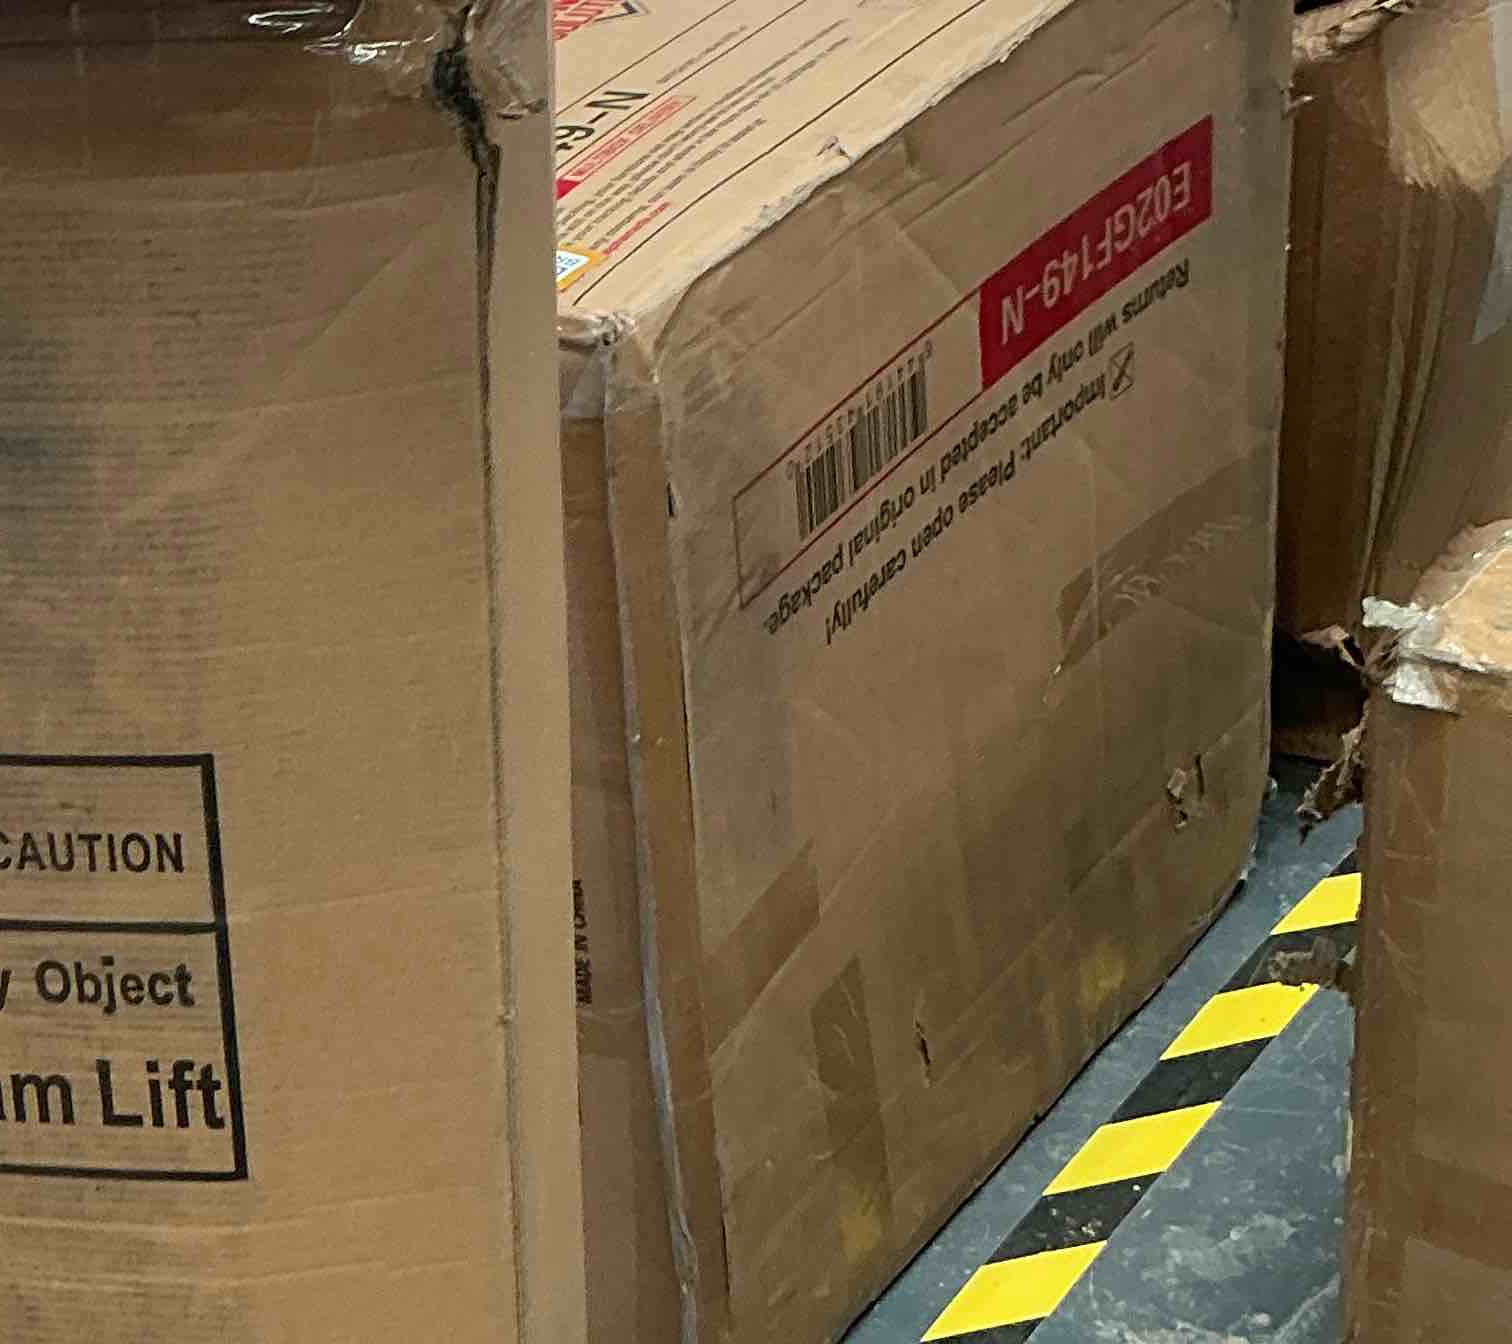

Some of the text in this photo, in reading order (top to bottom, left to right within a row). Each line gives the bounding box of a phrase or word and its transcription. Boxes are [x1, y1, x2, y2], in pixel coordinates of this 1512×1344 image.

[1000, 160, 1193, 346] E02GF149-N
[1120, 258, 1191, 332] Returns
[1046, 338, 1084, 393] only
[1087, 317, 1118, 360] will
[1021, 372, 1044, 408] be
[1022, 373, 1106, 461] Important:
[939, 394, 1019, 480] accepted
[920, 465, 937, 498] in
[958, 449, 1016, 514] Please
[847, 483, 916, 559] original
[911, 494, 954, 558] open
[762, 544, 845, 638] package.
[824, 546, 906, 646] carefully!
[34, 955, 196, 1015] Object
[95, 1057, 227, 1131] Lift
